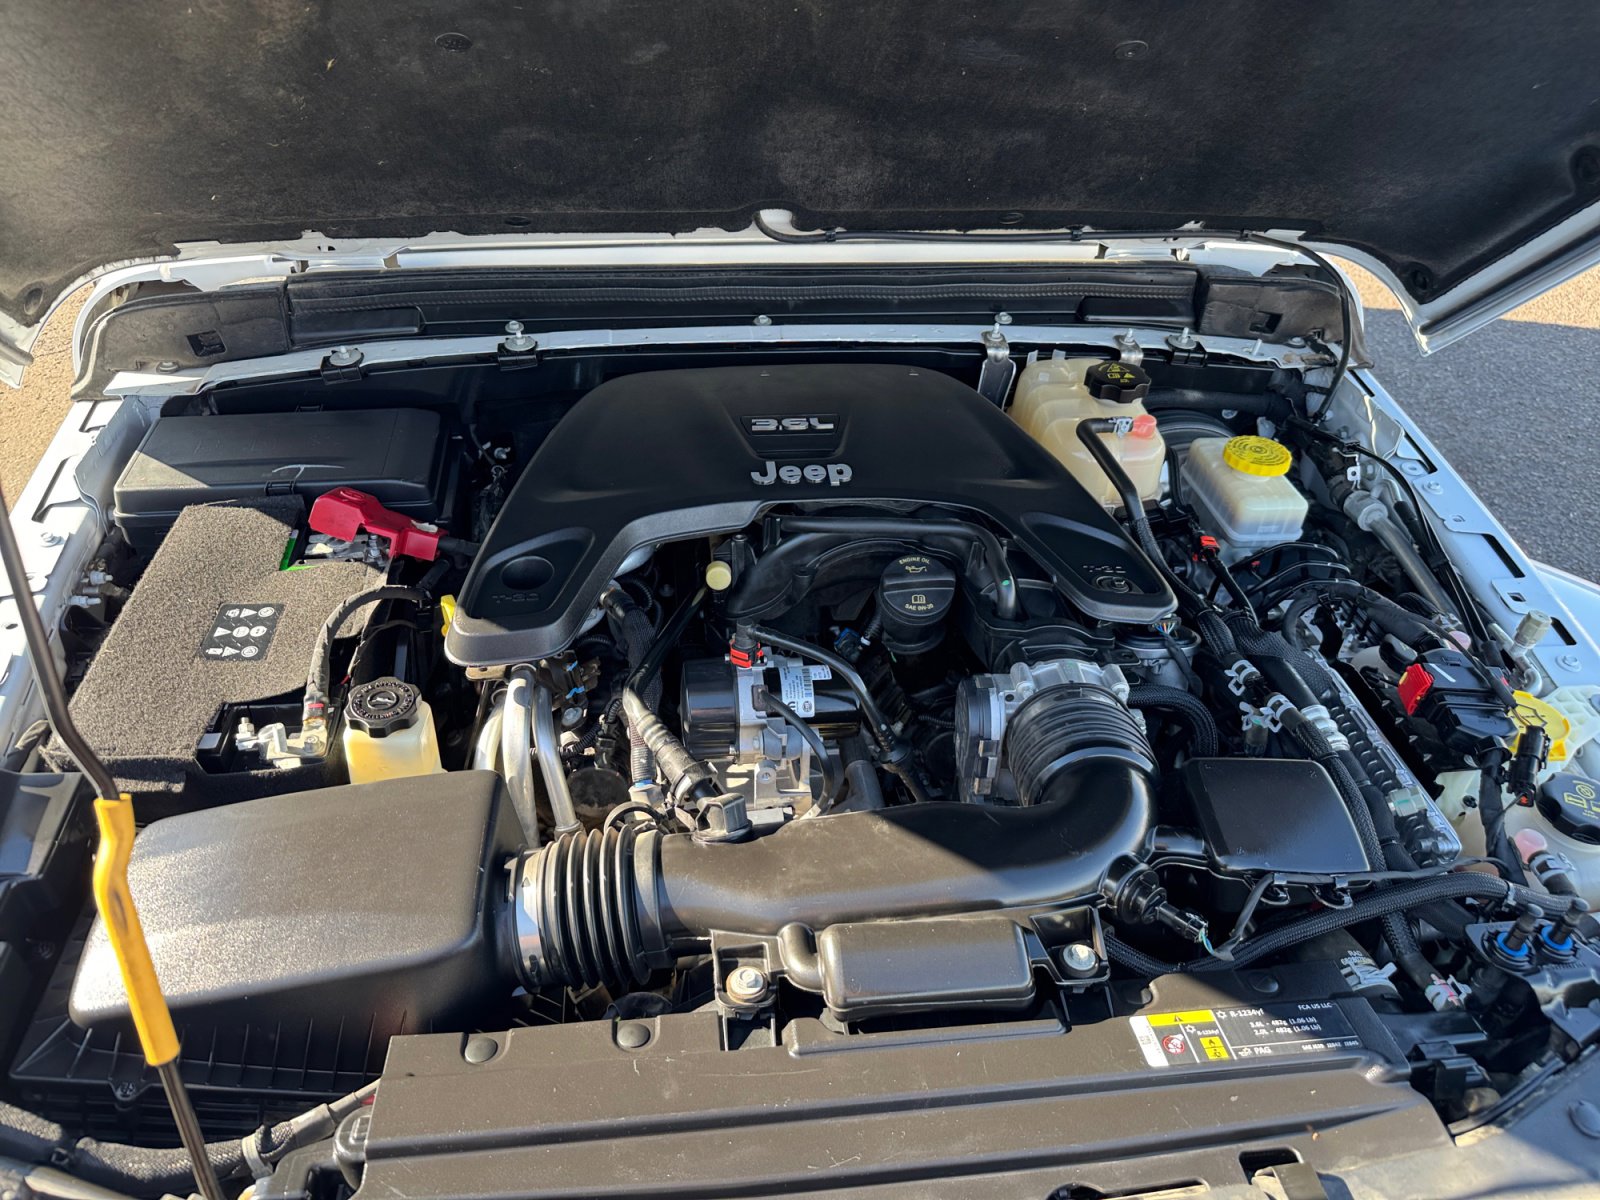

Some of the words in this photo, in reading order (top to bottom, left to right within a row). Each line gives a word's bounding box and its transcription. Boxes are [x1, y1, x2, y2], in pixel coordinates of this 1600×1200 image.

[751, 417, 834, 431] 3.6L
[750, 460, 853, 487] Jeep
[899, 556, 921, 565] ENGINE
[921, 557, 930, 565] OIL
[905, 603, 917, 611] SAE
[1229, 1007, 1264, 1018] R-1234yf
[1253, 1046, 1273, 1055] PAG
